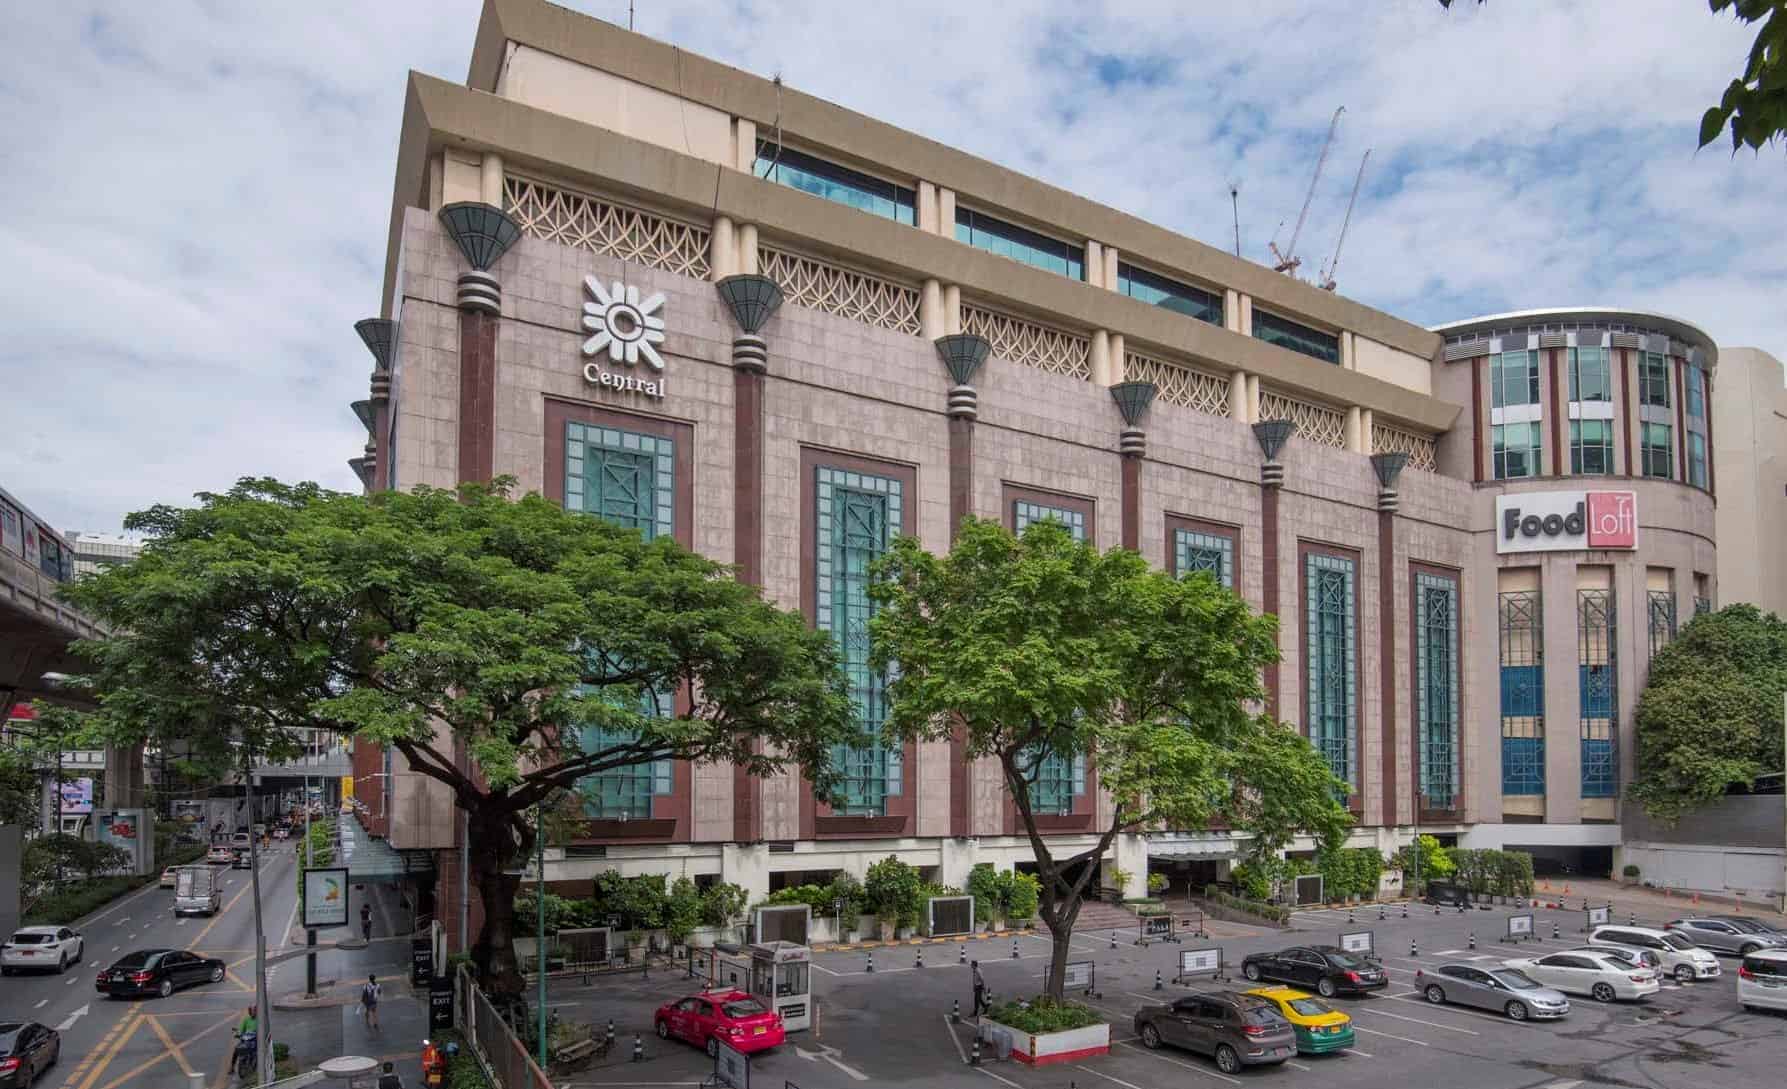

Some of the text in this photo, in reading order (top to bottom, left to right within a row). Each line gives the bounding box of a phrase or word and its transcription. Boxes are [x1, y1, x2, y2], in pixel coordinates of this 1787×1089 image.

[583, 363, 665, 397] Central
[1504, 496, 1632, 540] Food Loft
[432, 997, 450, 1006] EXIT
